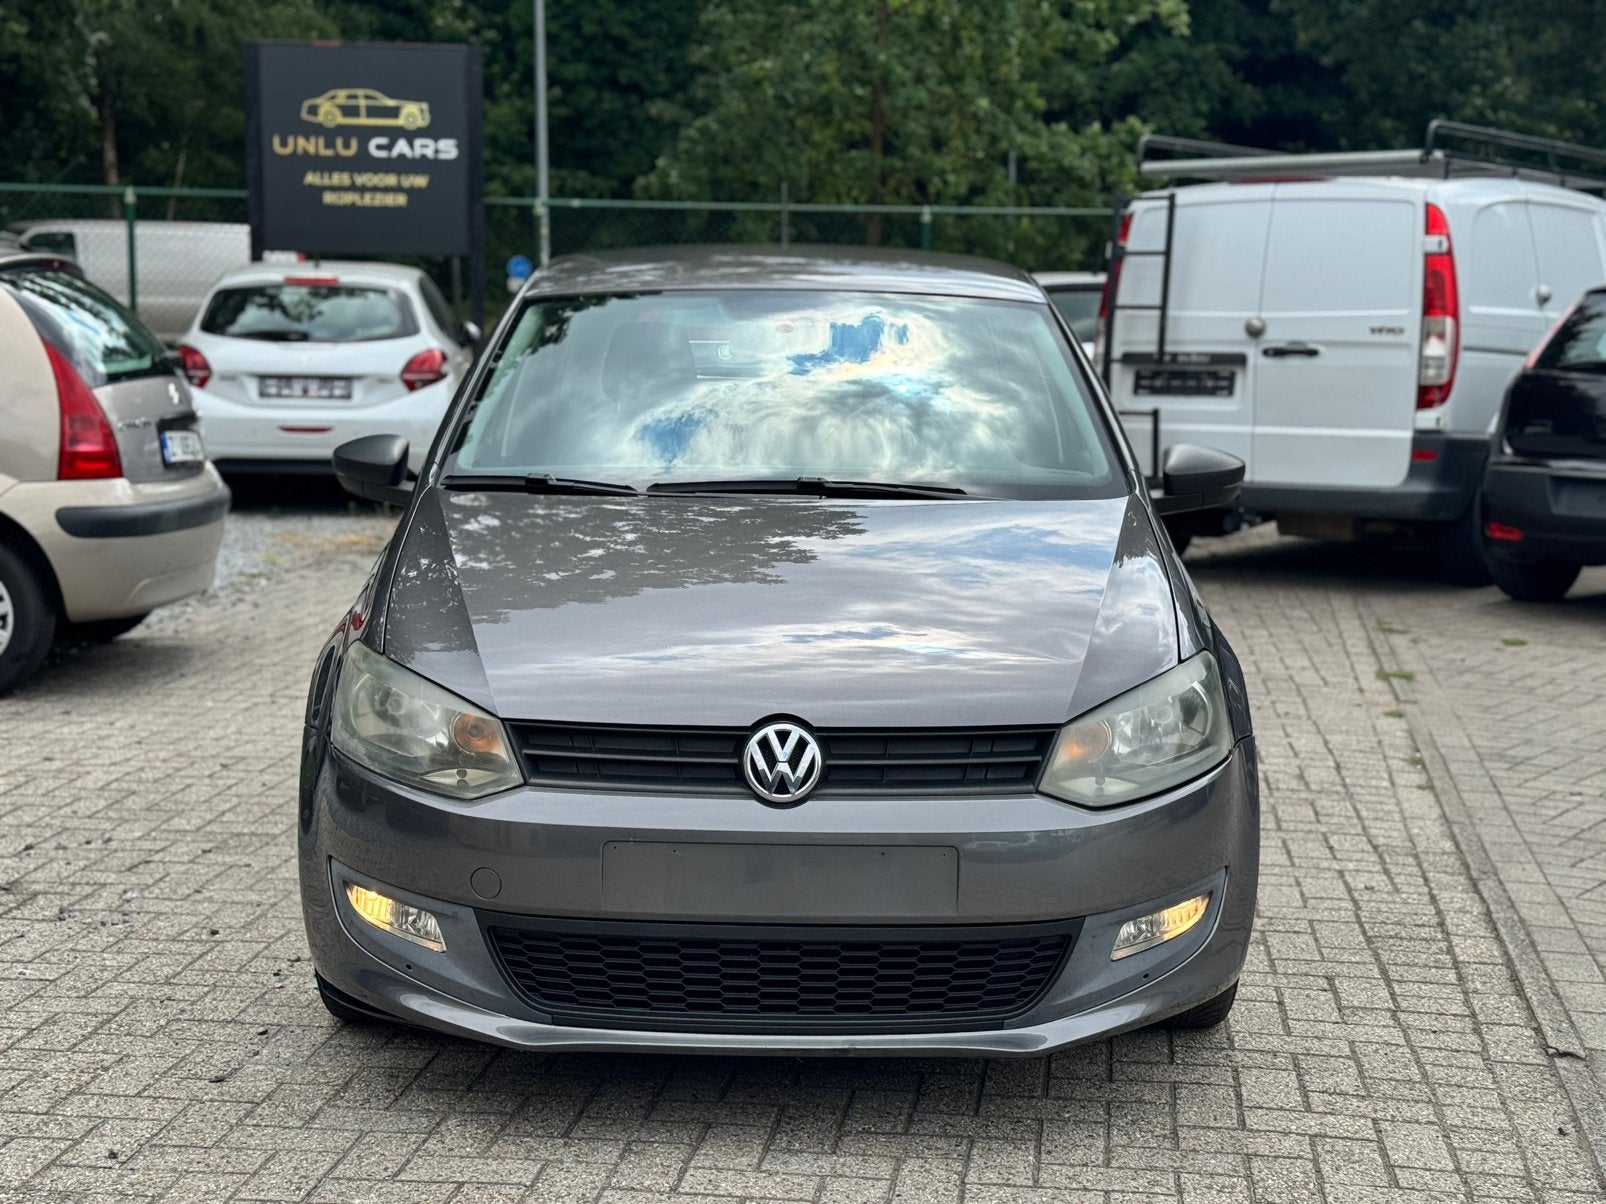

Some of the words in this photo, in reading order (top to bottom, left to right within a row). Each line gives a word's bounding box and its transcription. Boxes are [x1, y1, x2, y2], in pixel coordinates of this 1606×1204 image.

[272, 134, 358, 157] UNLU
[367, 136, 459, 160] CARS
[303, 171, 352, 187] ALLES
[352, 172, 399, 188] VOOR
[400, 173, 430, 189] UW
[746, 724, 818, 799] VW
